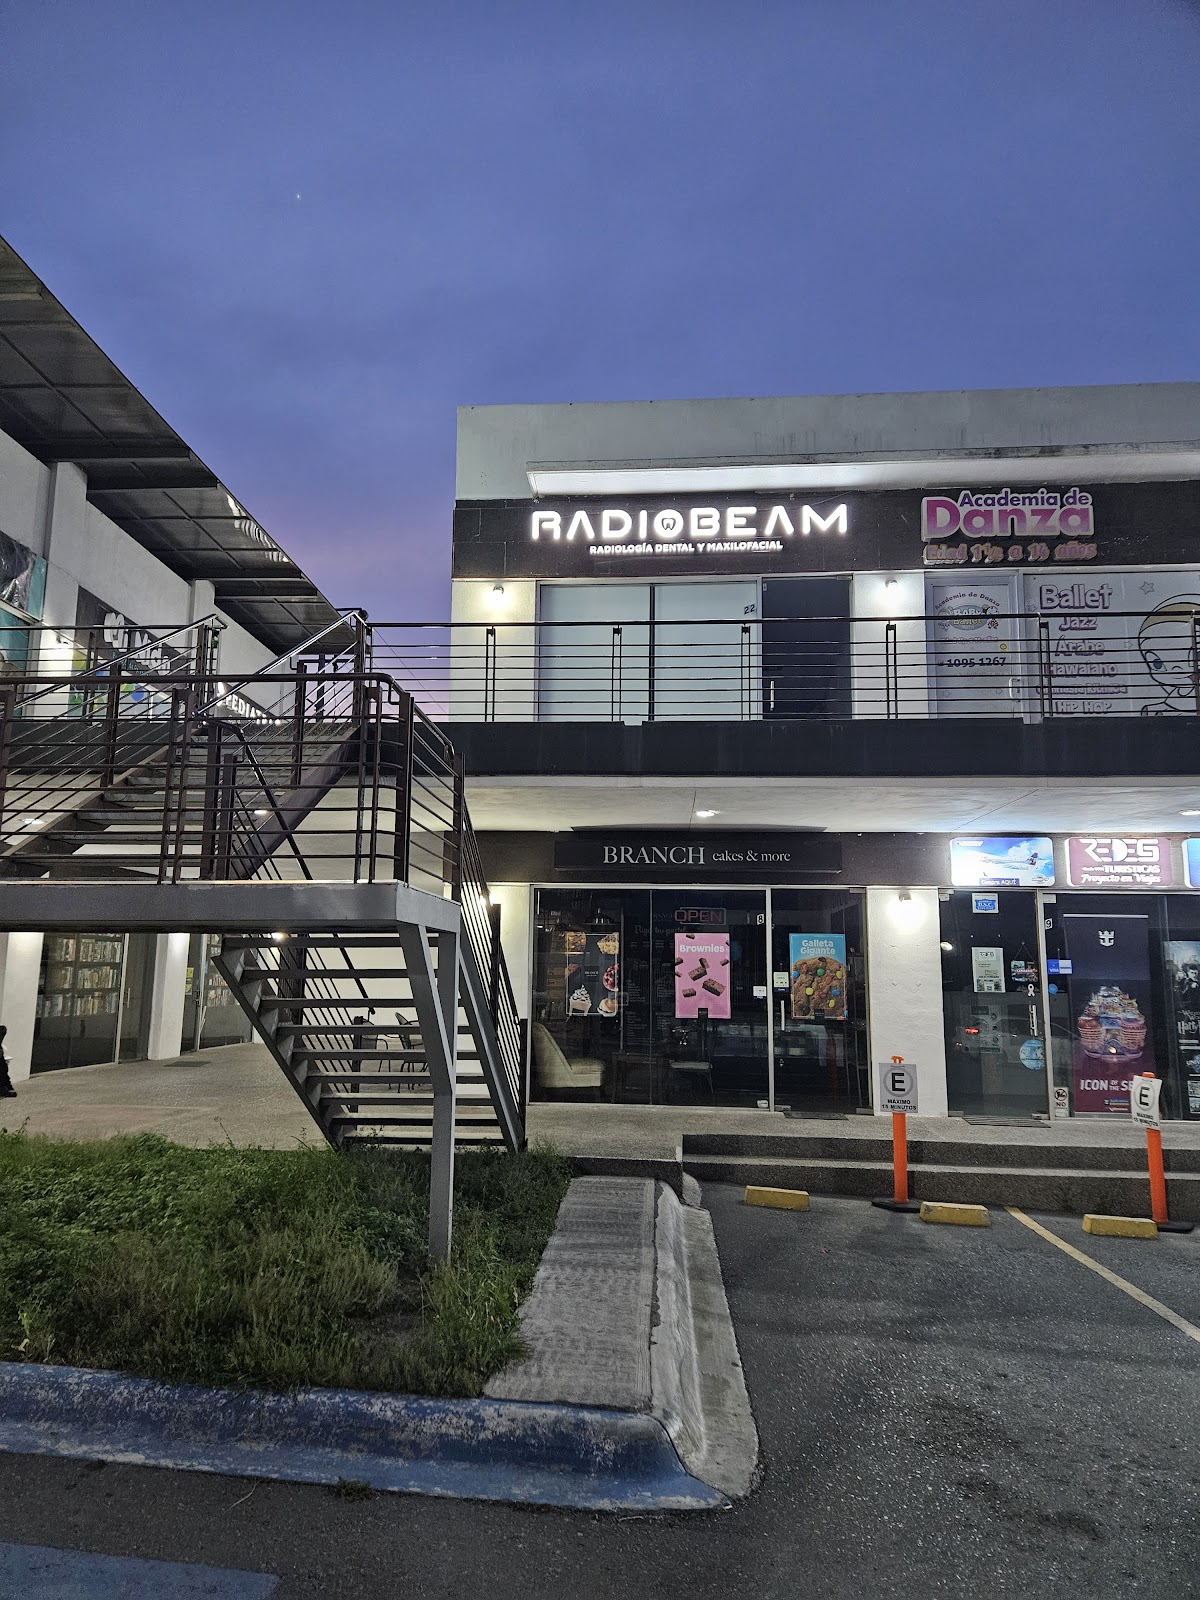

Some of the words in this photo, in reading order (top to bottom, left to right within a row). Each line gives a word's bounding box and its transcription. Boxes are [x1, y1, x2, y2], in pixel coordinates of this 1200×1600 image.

[959, 490, 1059, 507] Academia
[1065, 490, 1090, 506] de
[531, 503, 848, 541] RADIOBEAM
[925, 499, 1091, 536] Danza
[589, 543, 654, 555] RADIOLOGÍA
[655, 542, 695, 553] DENTAL
[696, 542, 707, 552] Y
[706, 540, 784, 551] MAXILOFACIAL
[1039, 583, 1114, 610] Ballet
[744, 604, 756, 616] 22
[1058, 615, 1099, 631] Jazz
[1054, 634, 1106, 657] Árabe
[946, 658, 976, 668] 1095
[978, 656, 1007, 667] 1267
[603, 846, 706, 865] BRANCH
[712, 850, 744, 862] cakes
[746, 850, 759, 862] &
[761, 852, 792, 862] more
[1079, 838, 1161, 863] REDES
[674, 909, 722, 922] OPEN
[679, 943, 725, 953] Brownies
[800, 947, 836, 956] Gigante
[801, 939, 834, 948] Galleta
[891, 1072, 906, 1092] E
[1080, 1079, 1109, 1091] ICON
[1120, 1080, 1134, 1091] SE
[1139, 1085, 1151, 1107] E
